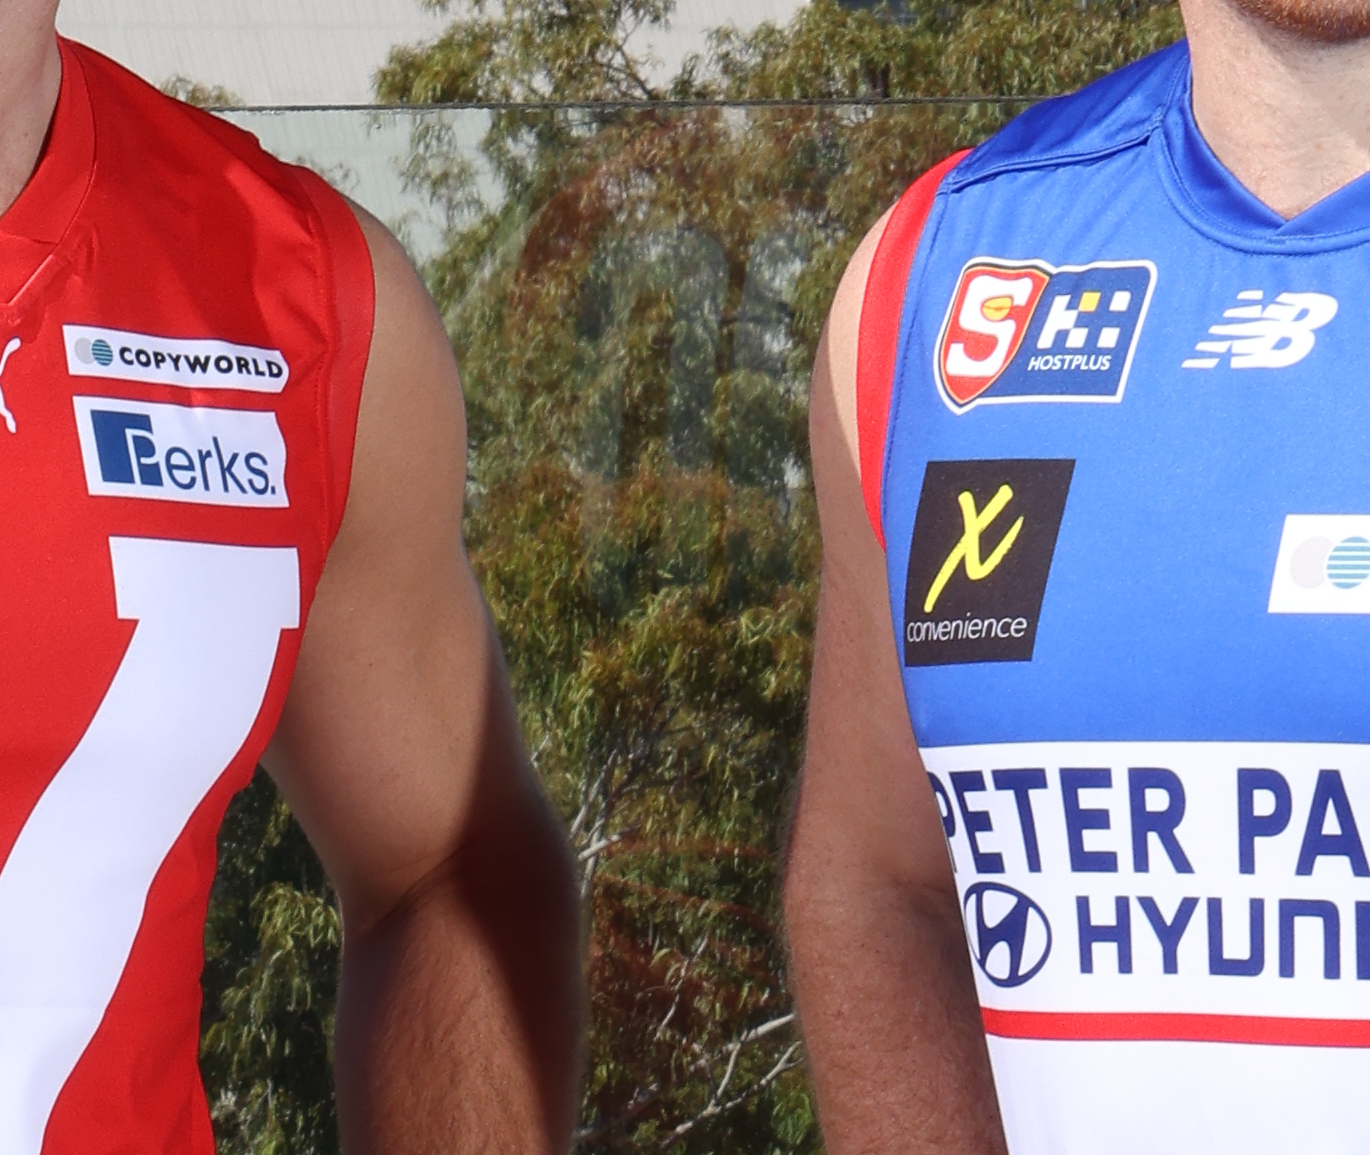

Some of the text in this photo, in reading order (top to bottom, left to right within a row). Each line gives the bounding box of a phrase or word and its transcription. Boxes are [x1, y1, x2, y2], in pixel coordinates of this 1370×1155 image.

[946, 274, 1033, 377] S
[119, 346, 284, 378] COPYWORLD
[1027, 354, 1111, 372] HOSTPLUS
[907, 612, 1027, 642] convenience
[926, 767, 1193, 874] PETER
